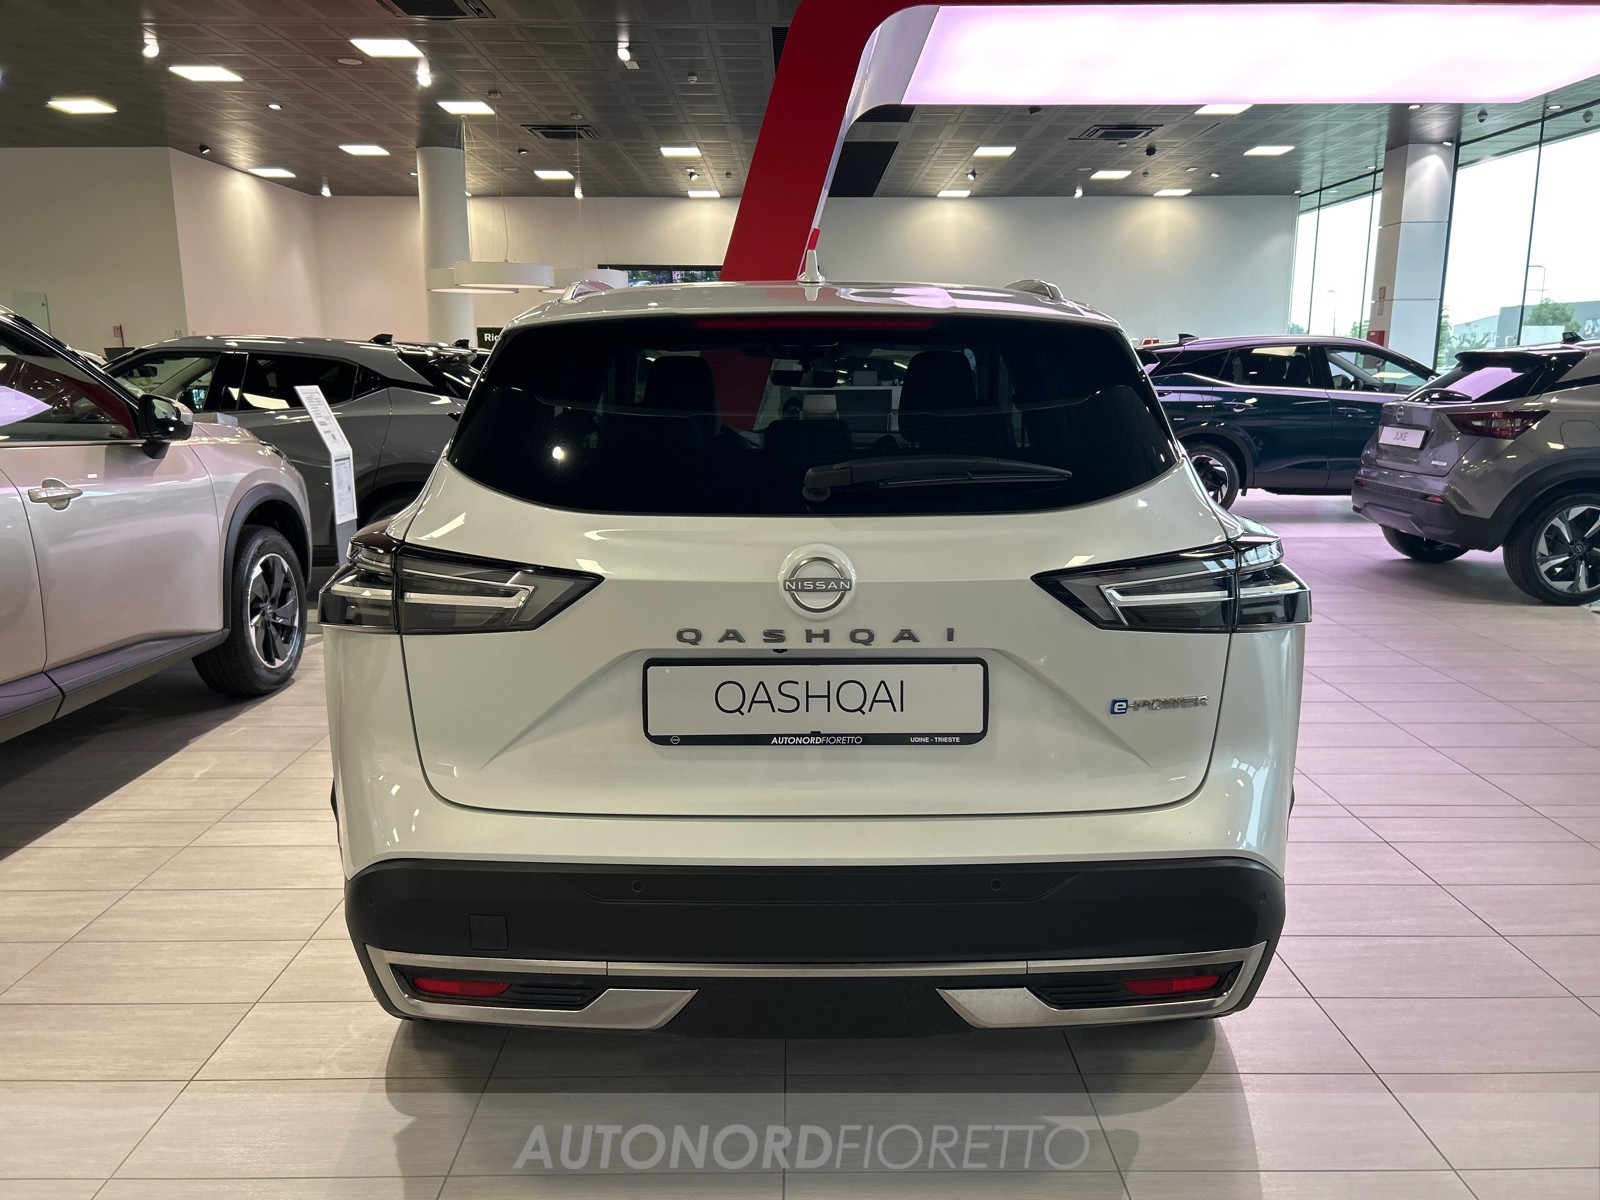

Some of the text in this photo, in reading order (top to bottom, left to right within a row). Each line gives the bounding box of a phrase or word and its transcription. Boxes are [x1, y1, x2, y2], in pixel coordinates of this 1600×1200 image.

[785, 581, 850, 590] NISSAN
[676, 627, 955, 647] QASHQAI
[714, 679, 905, 716] QASHQAI
[770, 736, 863, 745] AUTONORDFIORETTO
